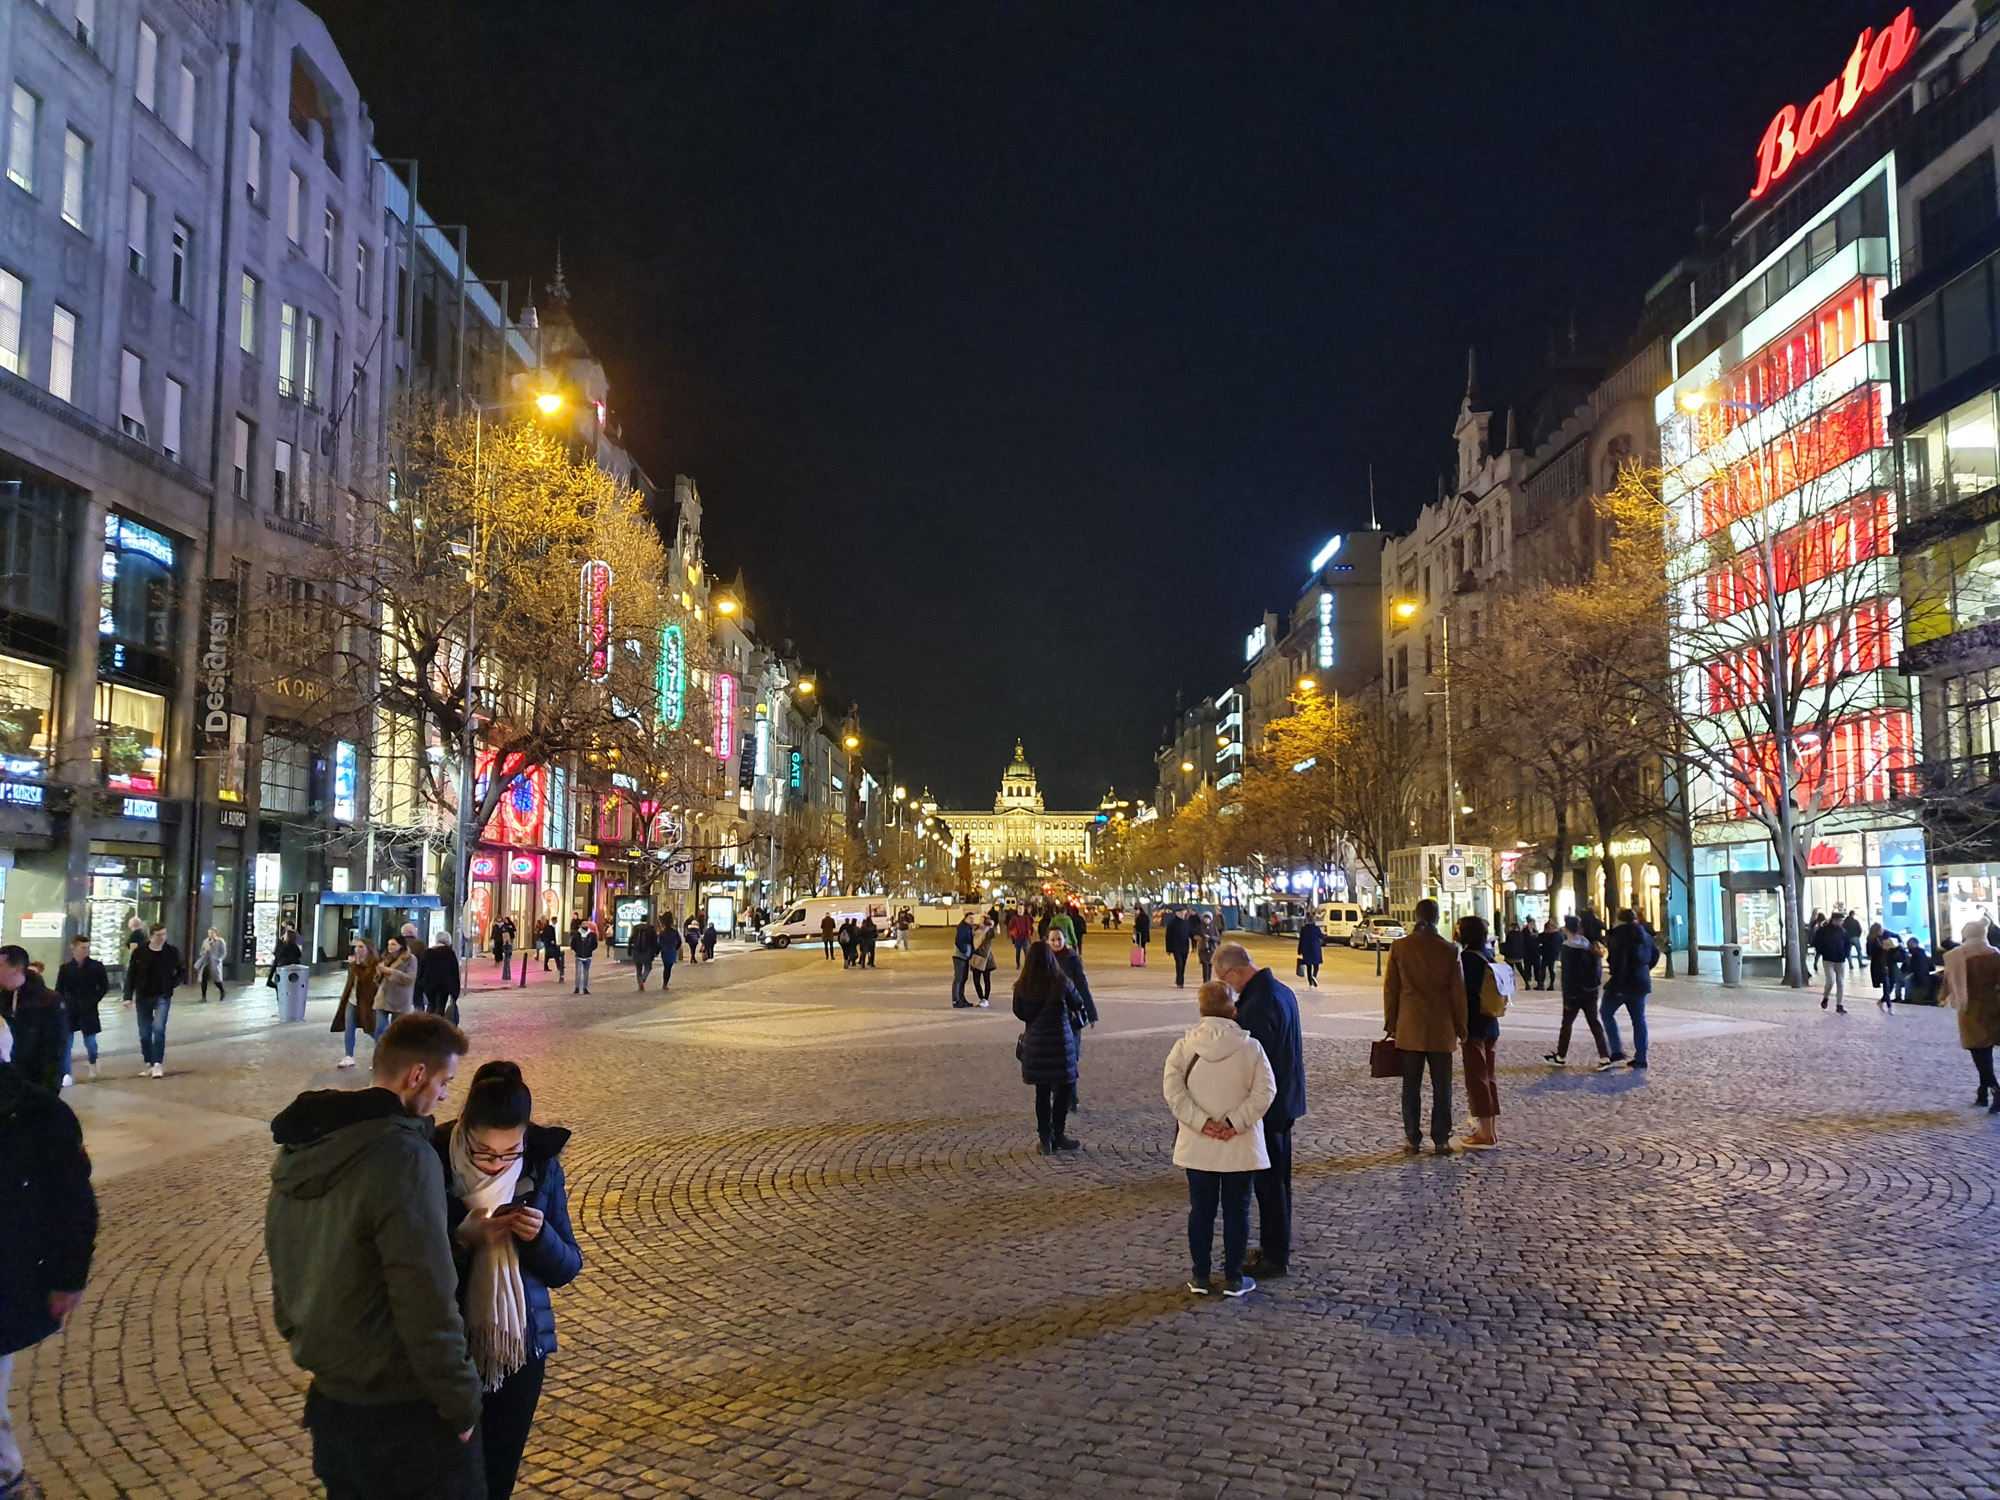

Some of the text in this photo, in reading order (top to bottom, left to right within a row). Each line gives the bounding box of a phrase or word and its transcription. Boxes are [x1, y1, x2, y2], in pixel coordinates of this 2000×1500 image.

[791, 752, 800, 788] GATE
[220, 810, 247, 827] LA BORSA
